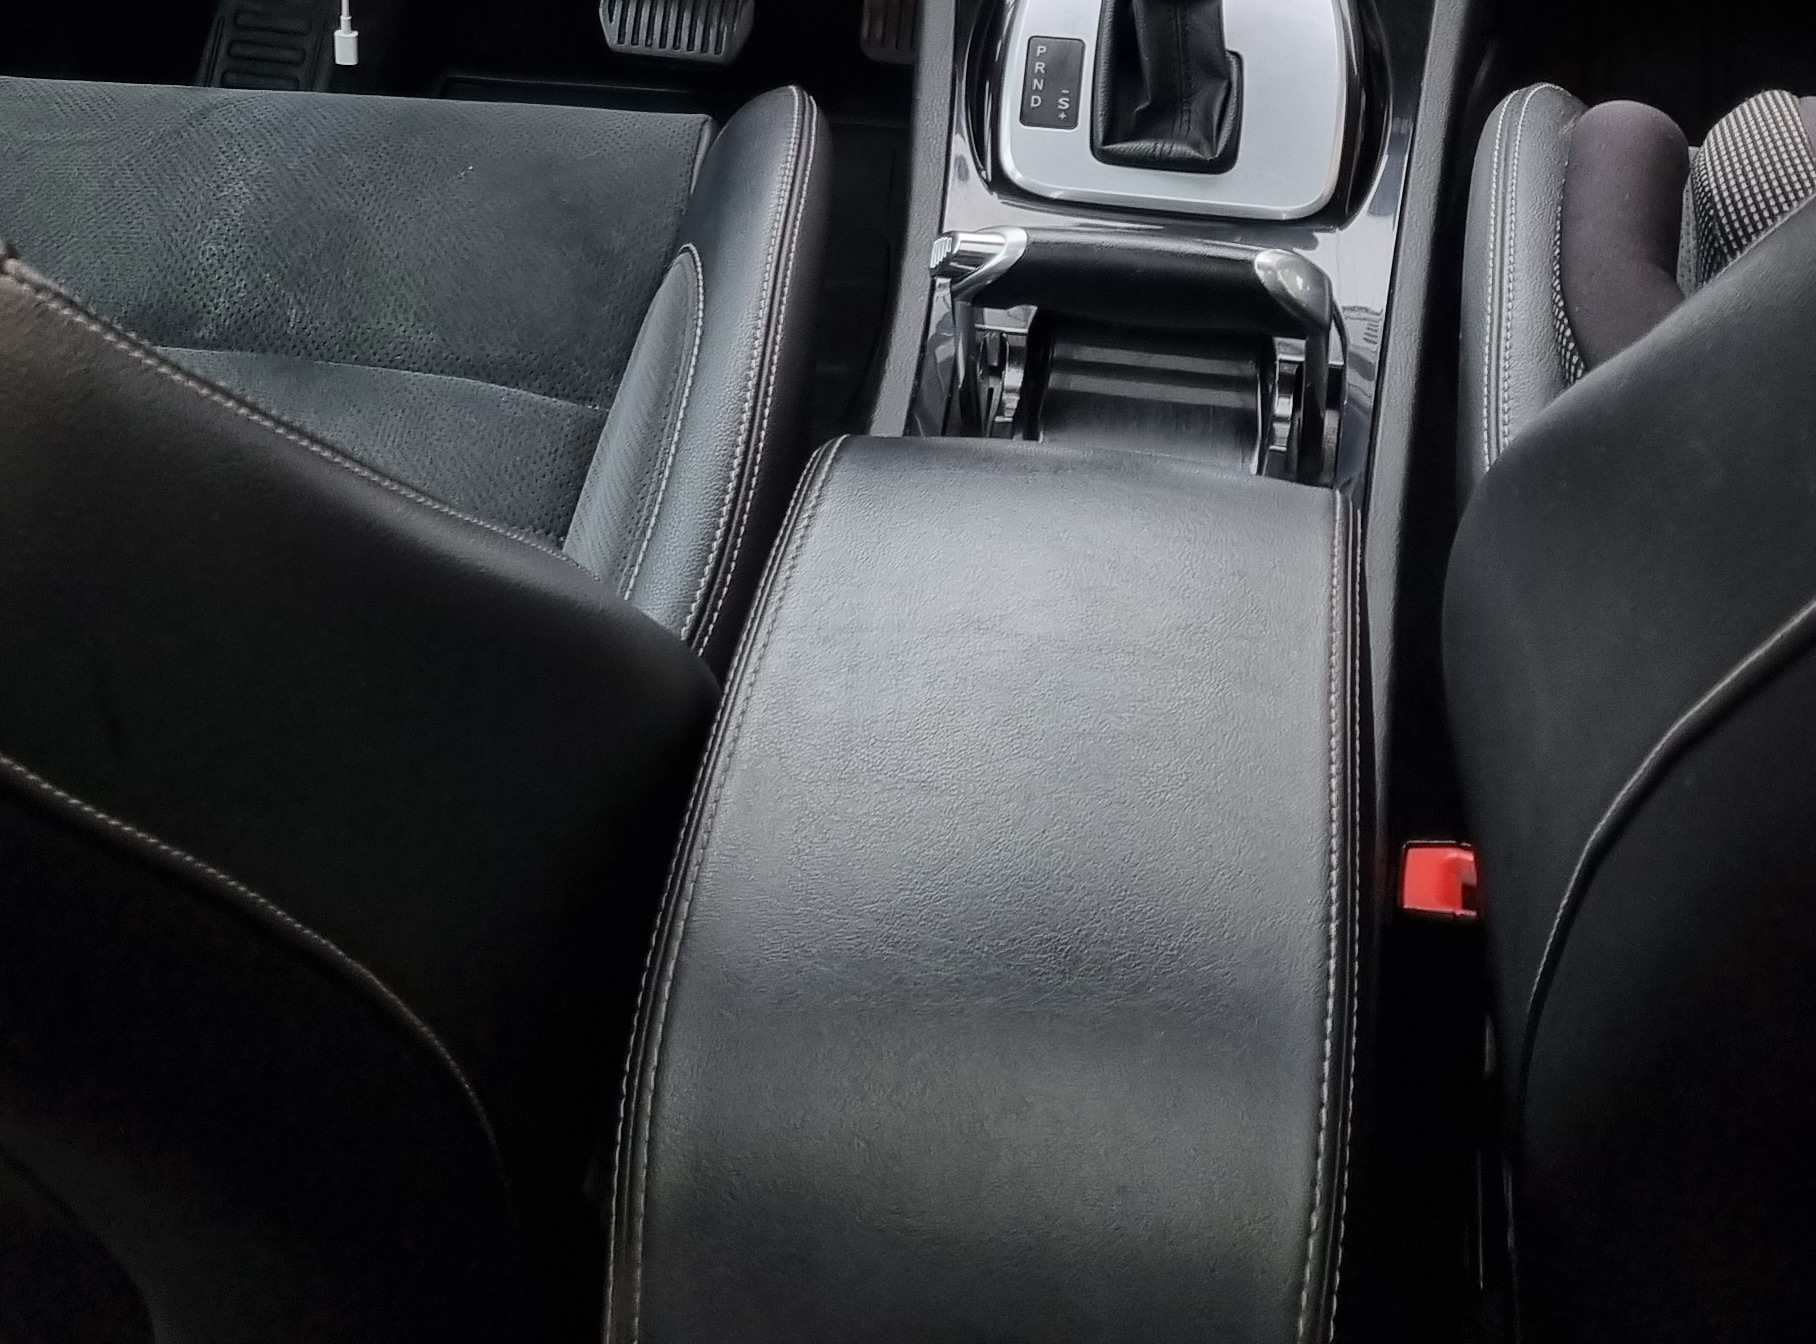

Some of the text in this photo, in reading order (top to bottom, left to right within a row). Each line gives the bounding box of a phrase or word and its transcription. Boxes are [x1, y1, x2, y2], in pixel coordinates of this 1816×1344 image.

[1036, 45, 1047, 57] P
[1034, 61, 1046, 74] R
[1032, 78, 1044, 90] N
[1030, 95, 1042, 107] D
[1057, 97, 1070, 110] S
